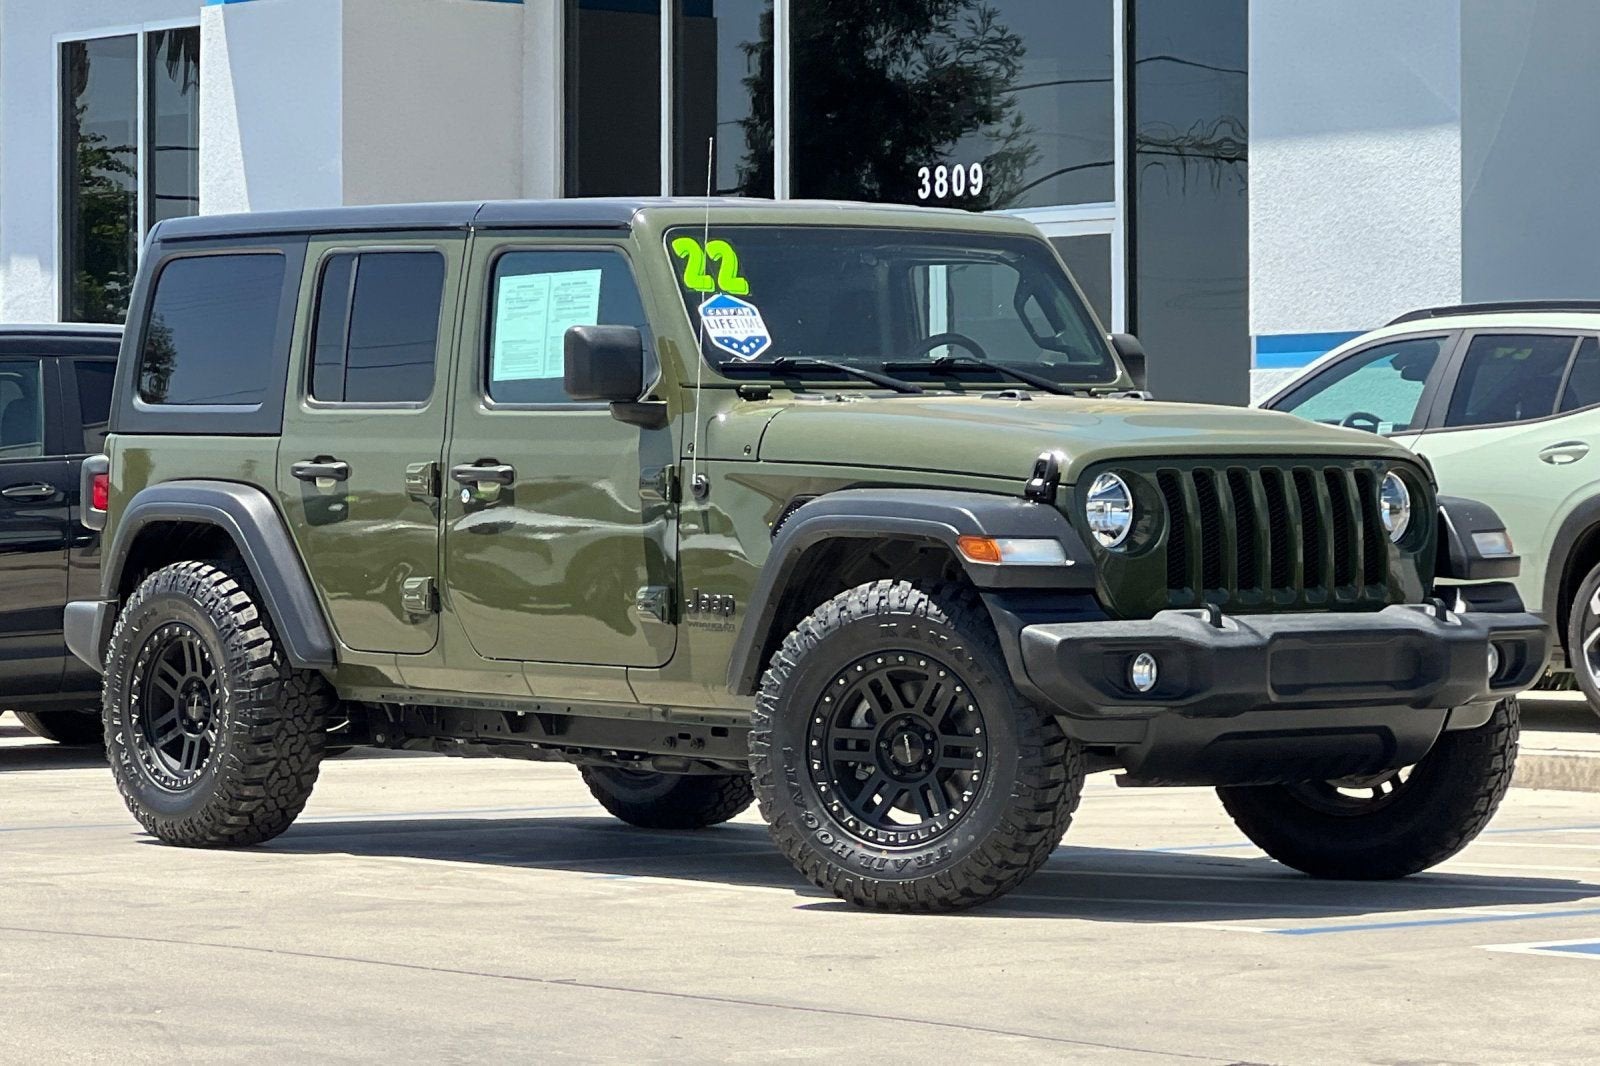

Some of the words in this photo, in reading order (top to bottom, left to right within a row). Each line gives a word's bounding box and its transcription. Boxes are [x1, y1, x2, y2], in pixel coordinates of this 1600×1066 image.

[917, 162, 983, 199] 3809
[671, 237, 749, 295] 22
[706, 318, 762, 329] LIFETIME
[685, 587, 735, 617] Jeep
[802, 810, 856, 859] HOG
[860, 848, 952, 873] TRAIL
